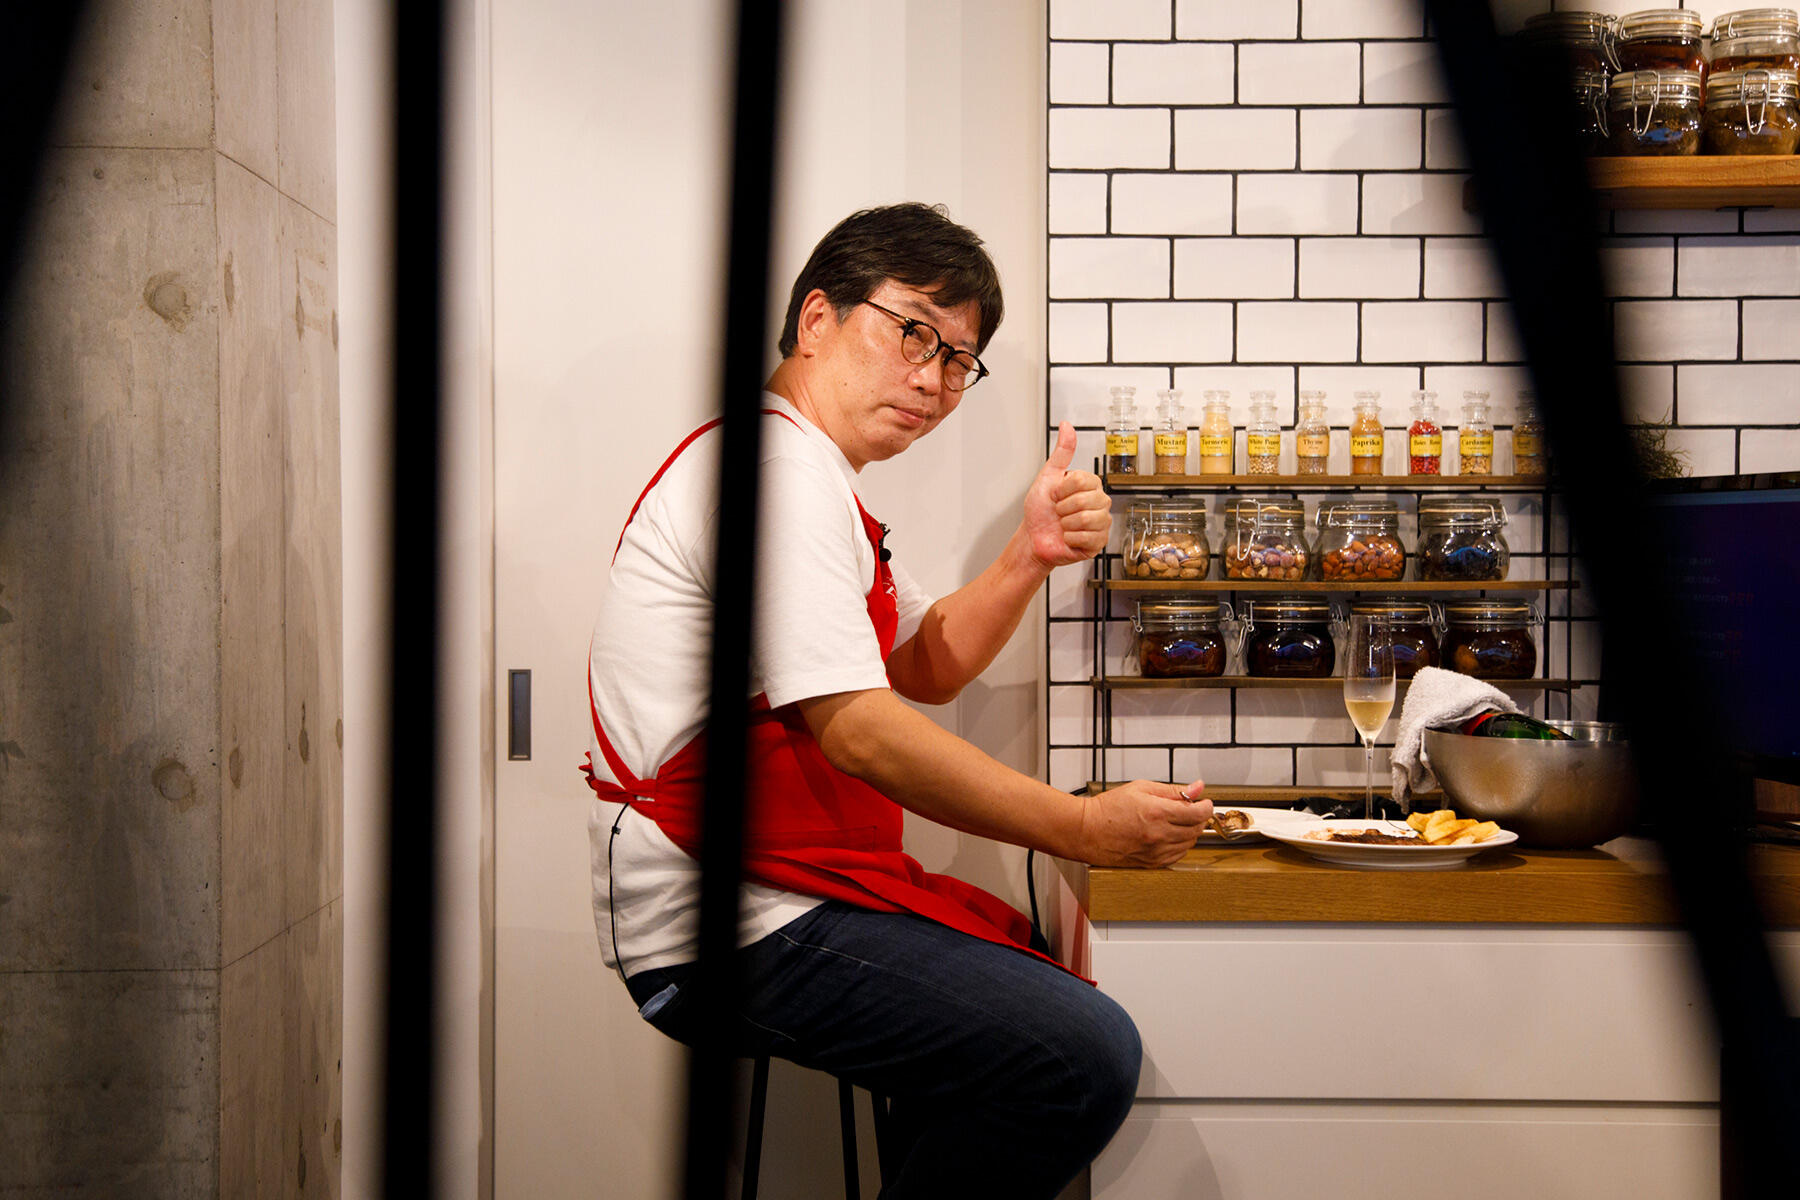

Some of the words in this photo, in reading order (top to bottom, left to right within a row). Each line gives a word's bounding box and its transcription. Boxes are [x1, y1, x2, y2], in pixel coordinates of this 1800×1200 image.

[1157, 438, 1185, 446] Mustard
[1303, 438, 1323, 446] Thyme
[1352, 439, 1380, 447] Paprika
